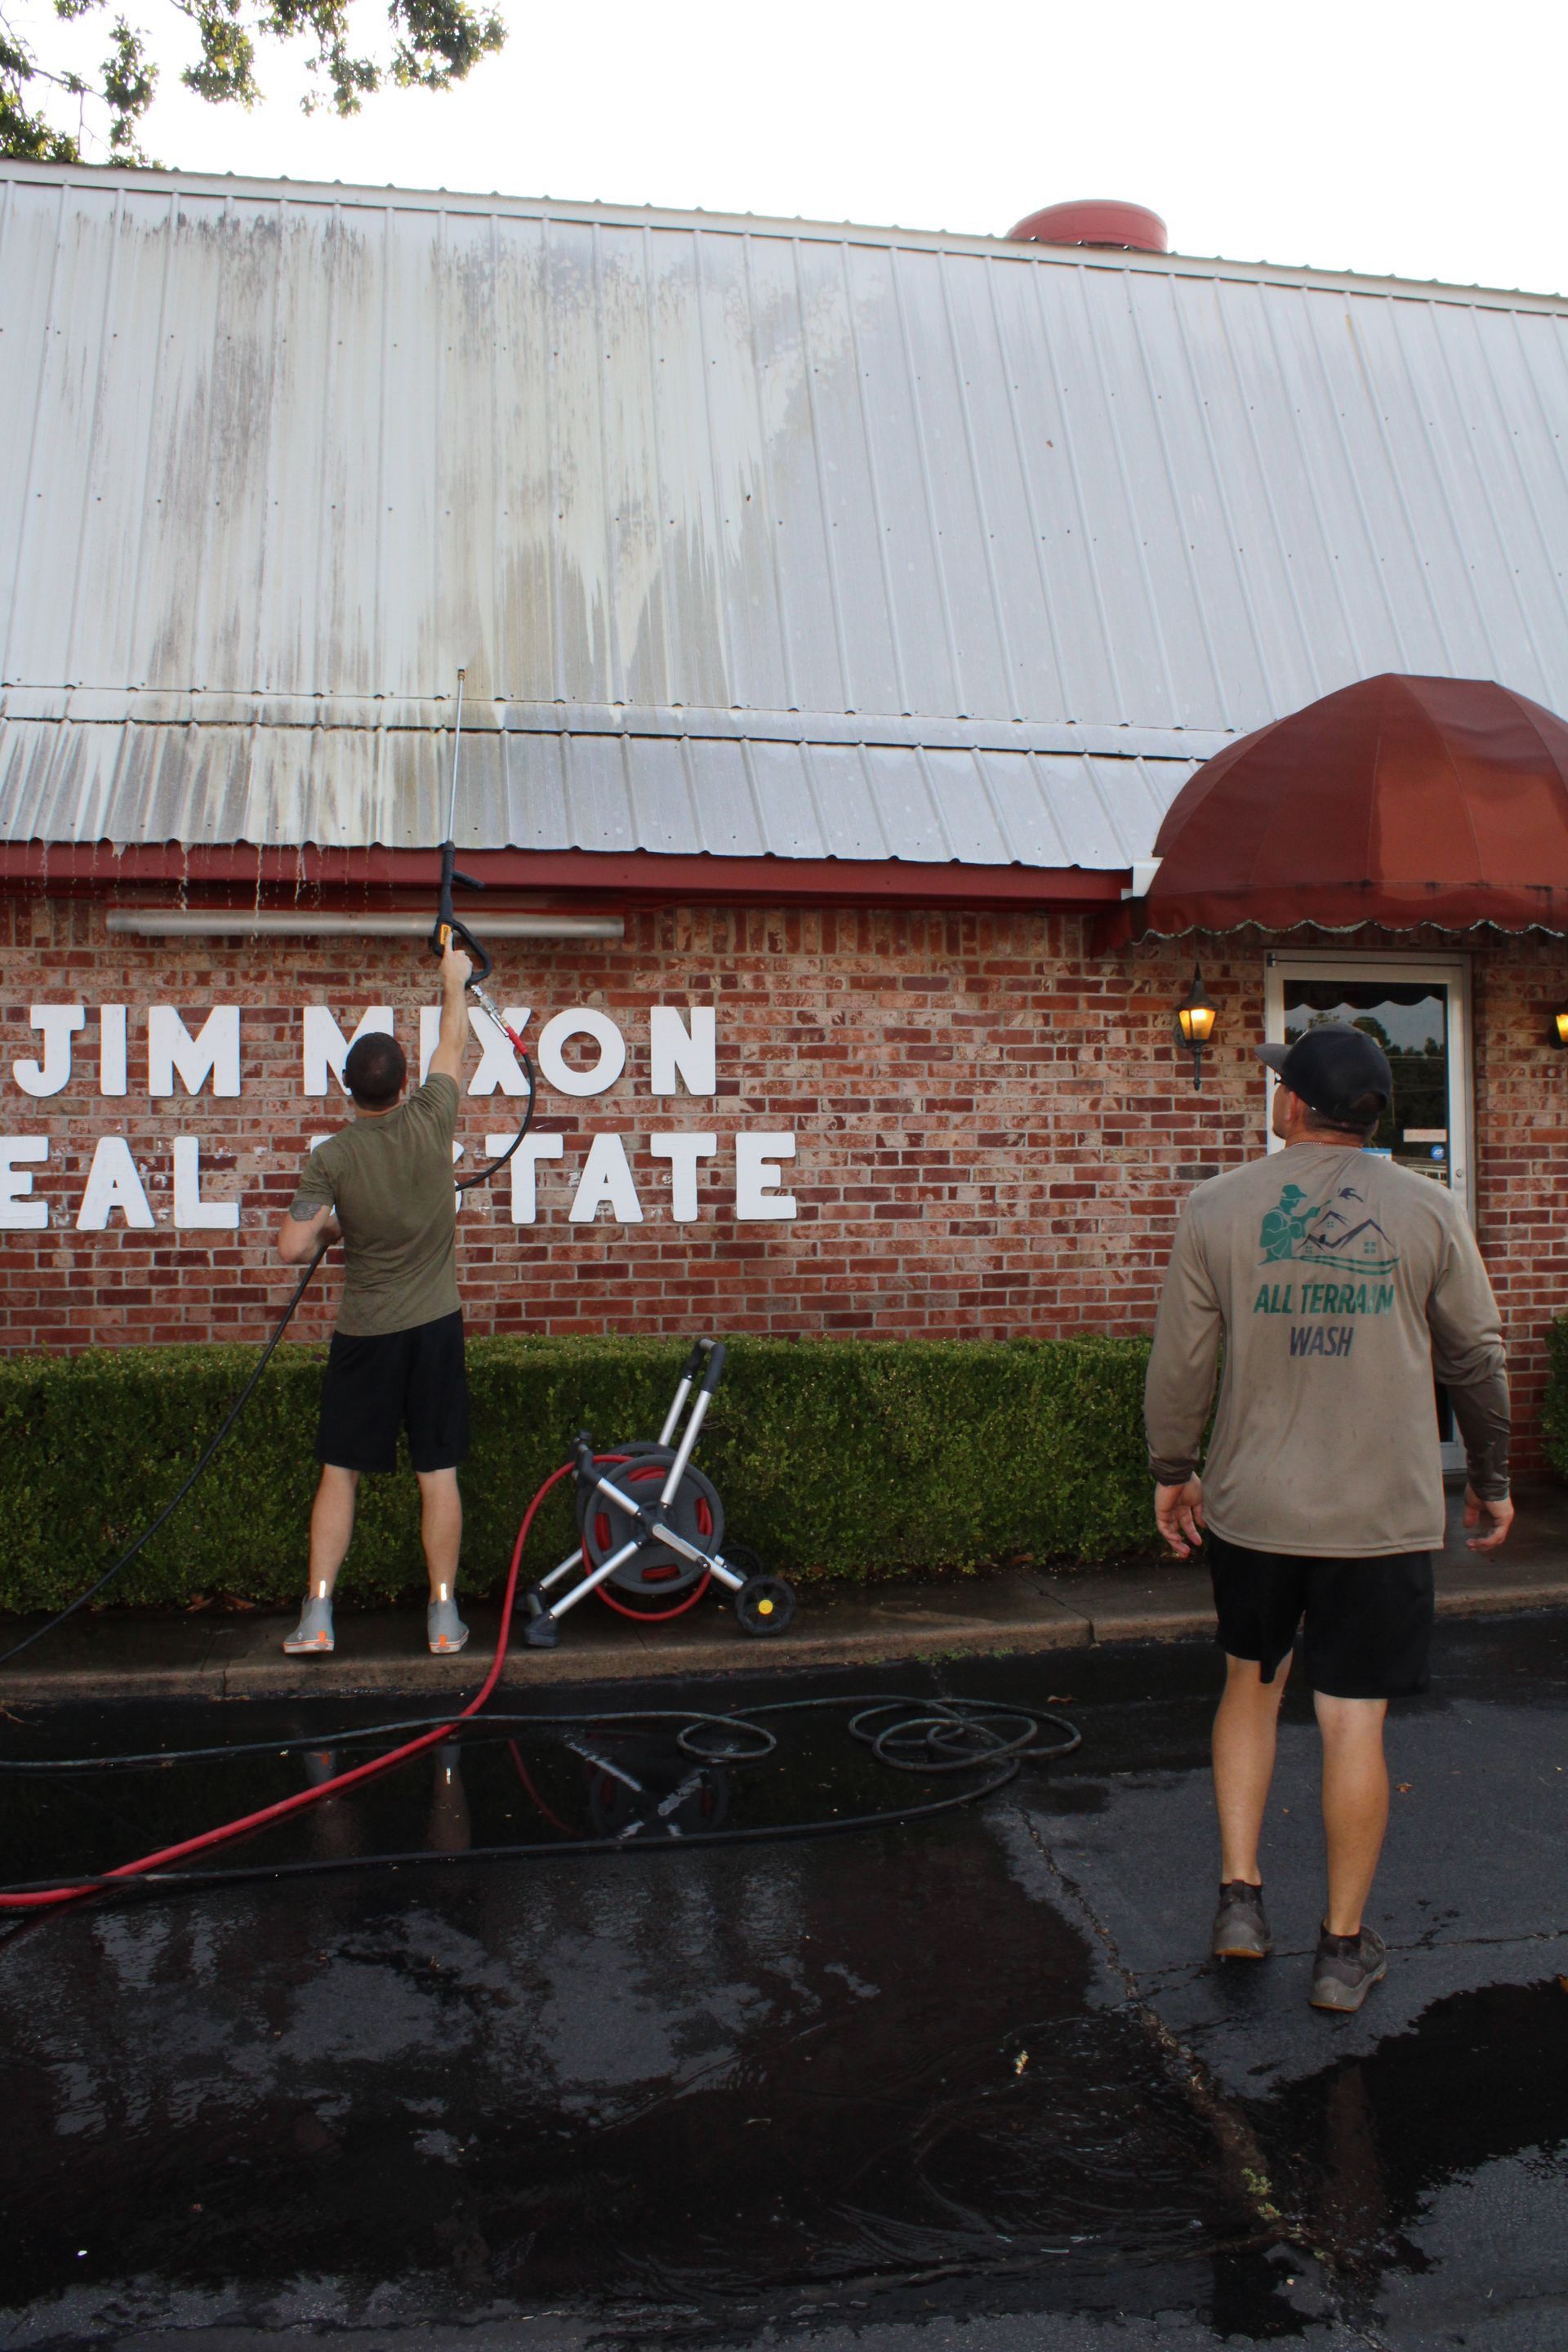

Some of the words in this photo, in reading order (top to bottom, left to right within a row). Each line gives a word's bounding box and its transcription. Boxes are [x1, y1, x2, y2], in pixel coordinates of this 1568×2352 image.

[12, 1004, 241, 1098] JIM
[0, 1135, 240, 1231] EAL
[310, 1132, 798, 1223] TATE
[1253, 1284, 1293, 1314] ALL
[1301, 1284, 1394, 1314] TERRAIN
[1290, 1325, 1354, 1356] WASH
